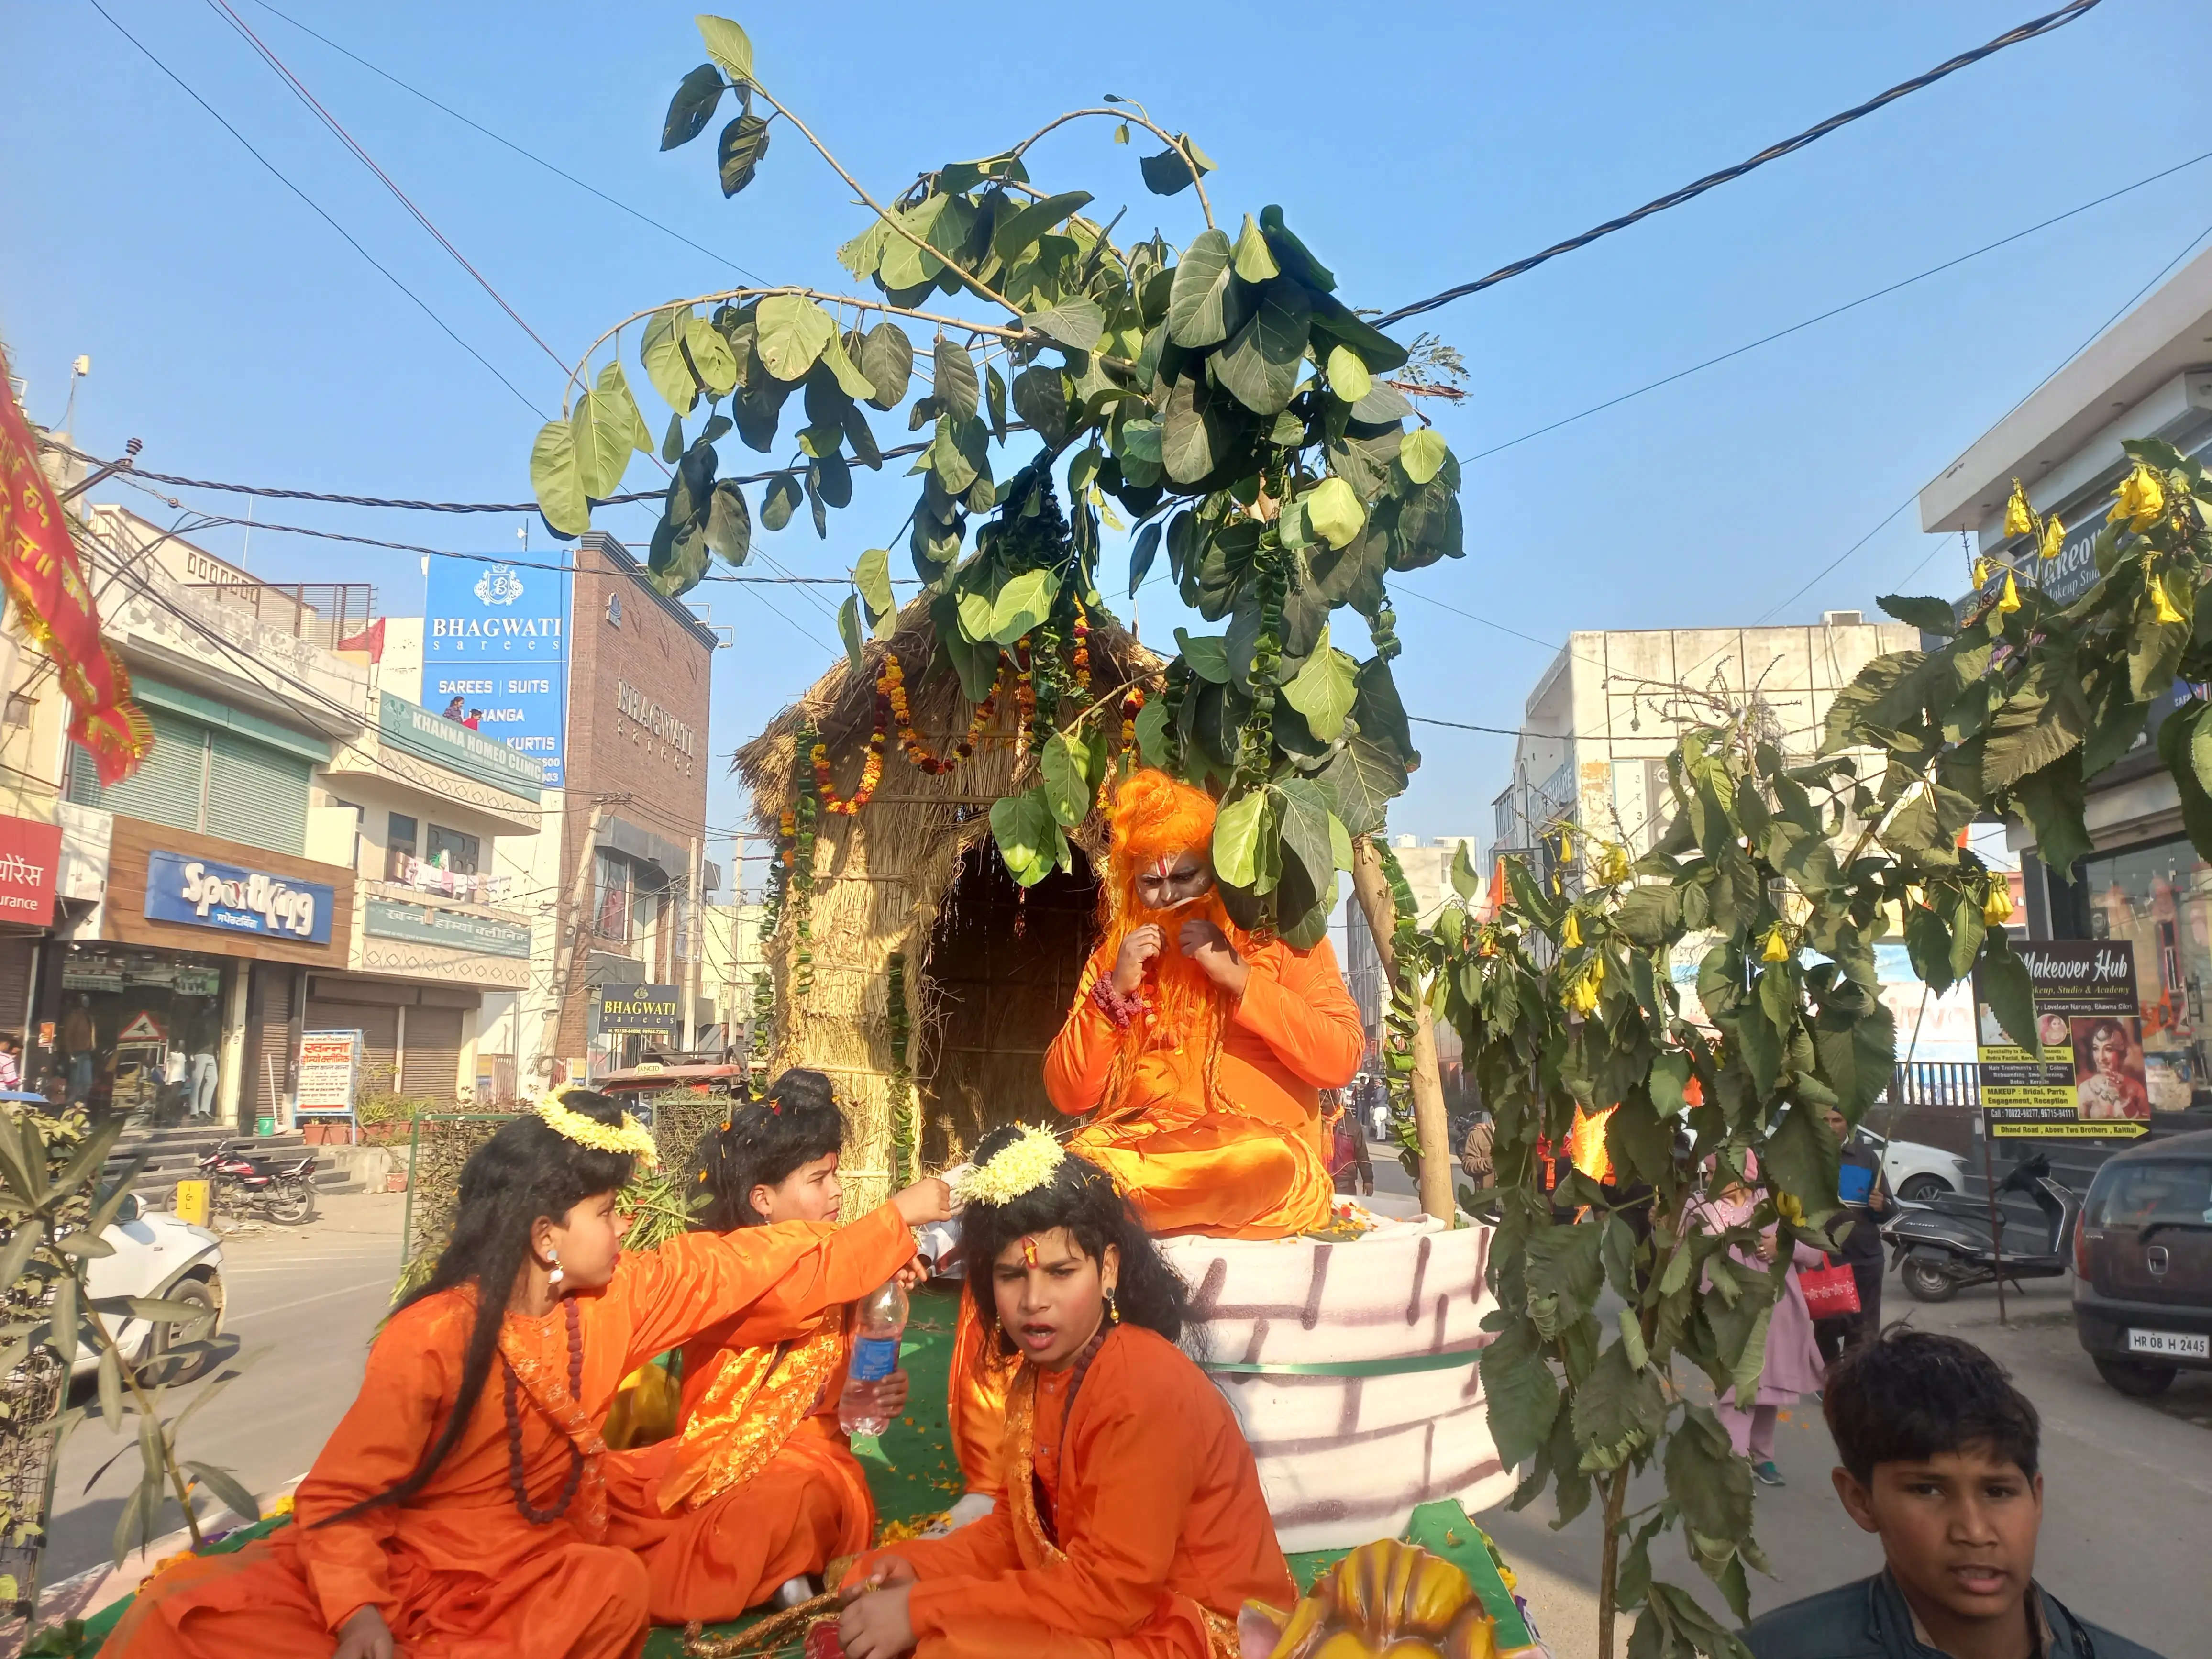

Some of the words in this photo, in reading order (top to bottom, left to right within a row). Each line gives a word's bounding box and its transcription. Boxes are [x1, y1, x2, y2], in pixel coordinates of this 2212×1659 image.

[2025, 529, 2103, 589] Makeov
[432, 618, 562, 637] BHAGWATI
[433, 640, 560, 651] sarees
[439, 680, 493, 694] SAREES
[509, 679, 549, 694] SUITS
[617, 677, 693, 759] BHAGWATI
[412, 711, 465, 748] KHANNA
[467, 734, 506, 765] HOMEO
[509, 753, 542, 781] CLINIC
[506, 736, 555, 751] KURTIS
[182, 863, 315, 936] Sportking
[2022, 951, 2090, 979] Makeover
[2092, 949, 2128, 982] Hub
[2033, 985, 2055, 995] keup,
[2057, 985, 2083, 994] Studio
[2085, 985, 2091, 994] &
[2094, 985, 2130, 995] Academy
[604, 1001, 676, 1015] BHAGWATI
[604, 1016, 674, 1024] sarees
[304, 1043, 350, 1053] खन्ना
[1991, 1108, 2001, 1118] Call
[2134, 1335, 2147, 1348] HR
[2150, 1337, 2163, 1349] 08
[2168, 1339, 2176, 1350] H
[2180, 1339, 2205, 1353] 2445
